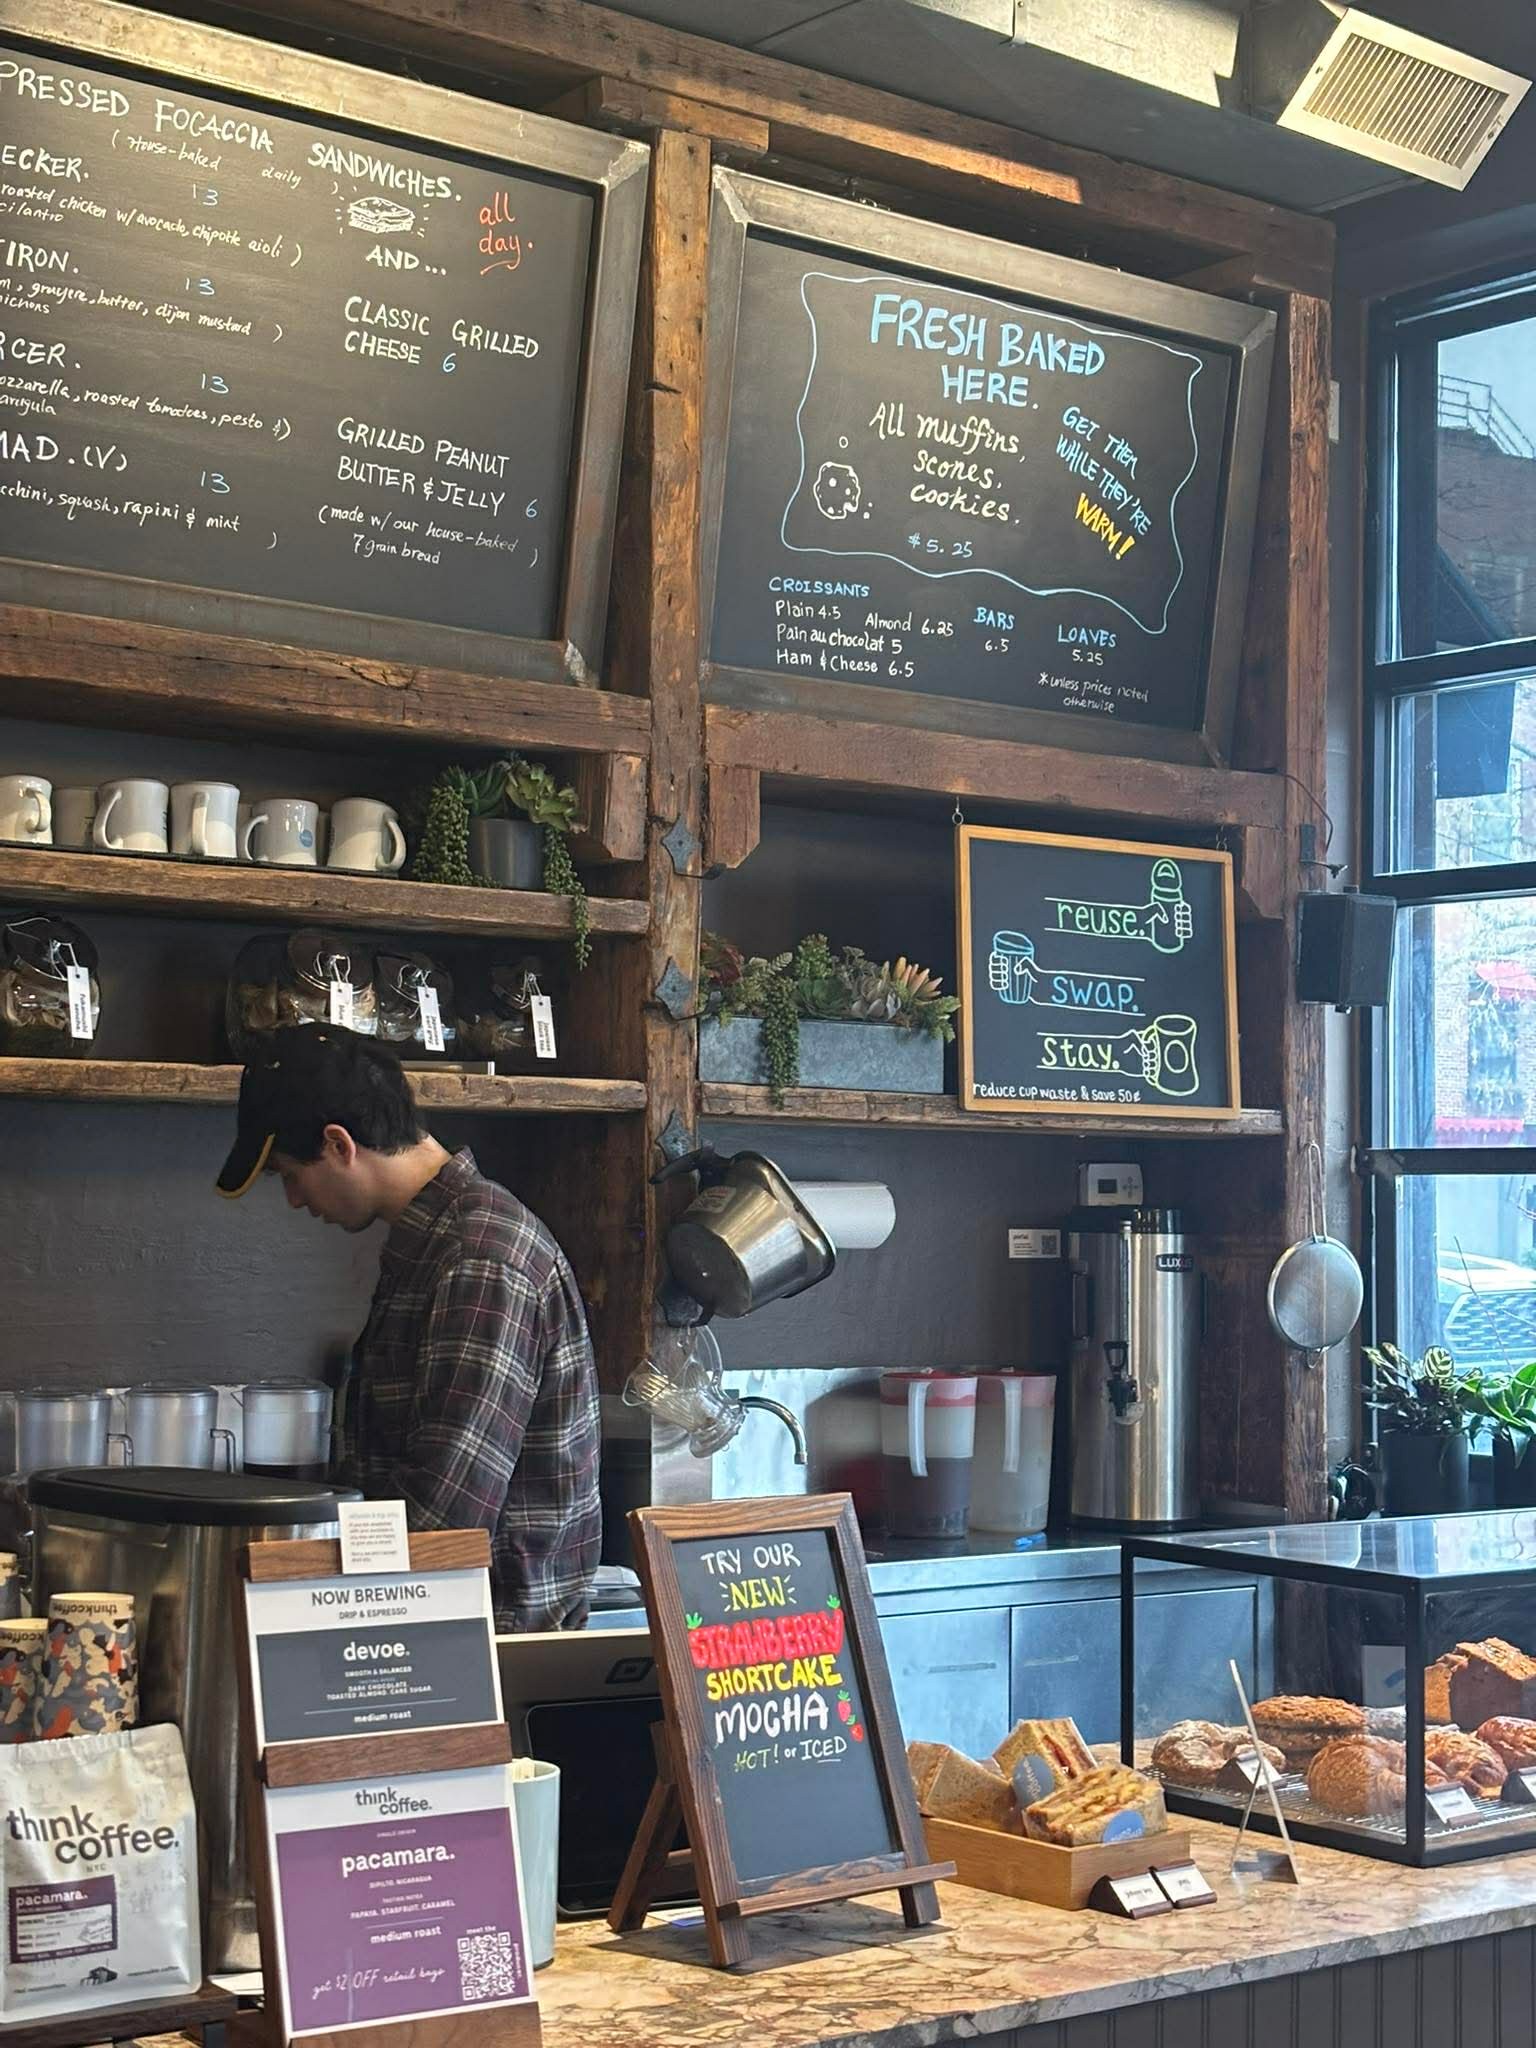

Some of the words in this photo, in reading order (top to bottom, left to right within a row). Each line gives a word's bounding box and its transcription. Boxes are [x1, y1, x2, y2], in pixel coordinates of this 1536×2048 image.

[155, 98, 274, 154] FOCACCIA
[307, 142, 462, 202] SANDWICHES.
[261, 166, 302, 189] daily
[192, 183, 219, 206] 13
[478, 191, 515, 226] all
[1, 183, 56, 204] roasted
[59, 195, 107, 219] chicken
[192, 224, 241, 248] chipotle
[248, 234, 284, 258] aioli
[0, 238, 80, 274] IRON.
[365, 244, 447, 276] AND...
[478, 229, 534, 272] day.
[185, 276, 216, 296] 13
[155, 302, 191, 325] dijon
[198, 313, 252, 336] mustard
[344, 295, 430, 337] CLASSIC
[451, 318, 539, 359] GRILLED
[869, 293, 988, 361] FRESH
[997, 323, 1106, 376] BAKED
[344, 330, 422, 365] CHEESE
[441, 352, 457, 373] 6
[200, 373, 229, 394] 13
[940, 363, 1040, 411] HERE.
[84, 389, 140, 410] roasted
[218, 411, 263, 434] pesto
[336, 416, 425, 455] GRILLED
[434, 439, 510, 478] PEANUT
[868, 401, 906, 441] All
[916, 413, 1026, 463] muffins,
[1062, 406, 1101, 442] GET
[1103, 433, 1138, 480] THEM
[200, 471, 231, 494] 13
[337, 455, 416, 495] BUTTER
[437, 479, 506, 516] JELLY
[524, 498, 538, 518] 6
[1055, 433, 1100, 482] WHILE
[1098, 467, 1152, 536] THEY'RE
[122, 499, 180, 527] rapini
[205, 513, 241, 532] mint
[1074, 492, 1136, 561] WARM!
[393, 517, 420, 533] our
[426, 521, 520, 553] house-baked
[401, 543, 441, 564] bread
[768, 576, 871, 598] CROISSANTS
[775, 600, 815, 618] Plain
[818, 604, 842, 620] 4.5
[864, 611, 913, 632] Almond
[921, 617, 954, 637] 6.25
[973, 606, 1016, 631] BARS
[776, 623, 808, 643] Pain
[810, 629, 827, 644] au
[828, 628, 885, 653] chocolat
[891, 638, 903, 655] 5
[984, 637, 1010, 653] 6.5
[1057, 623, 1117, 648] LOAVES
[776, 648, 812, 666] Ham
[829, 655, 879, 673] Cheese
[888, 660, 915, 678] 6.5
[1071, 648, 1104, 666] 5.25
[1062, 696, 1116, 714] otherwise
[1056, 901, 1146, 937] reuse.
[972, 1081, 1017, 1098] reduce
[1018, 1085, 1038, 1099] cup
[1040, 1087, 1079, 1101] waste
[1080, 1085, 1090, 1101] &
[1091, 1088, 1116, 1102] save
[700, 1549, 741, 1575] TRY
[753, 1542, 801, 1569] OUR
[311, 1590, 350, 1607] NOW
[354, 1583, 431, 1604] BREWING.
[729, 1575, 786, 1611] NEW
[338, 1610, 358, 1620] DRIP
[359, 1609, 366, 1619] &
[366, 1606, 408, 1618] ESPRESSO
[343, 1641, 411, 1661] devoe.
[687, 1608, 845, 1669] STRAWBERRY
[706, 1653, 843, 1701] SHORTCAKE
[353, 1712, 388, 1723] medium
[389, 1710, 412, 1720] roast
[714, 1691, 829, 1744] MOCHA
[783, 1746, 797, 1759] or
[799, 1735, 847, 1761] ICED
[355, 1786, 398, 1807] think
[379, 1797, 433, 1816] coffee.
[7, 1804, 99, 1843] think
[55, 1822, 180, 1865] coffee.
[341, 1844, 456, 1878] pacamara.
[15, 1890, 89, 1909] pacamara.
[370, 1930, 412, 1944] medium
[414, 1925, 442, 1938] roast
[353, 1968, 380, 1989] OFF
